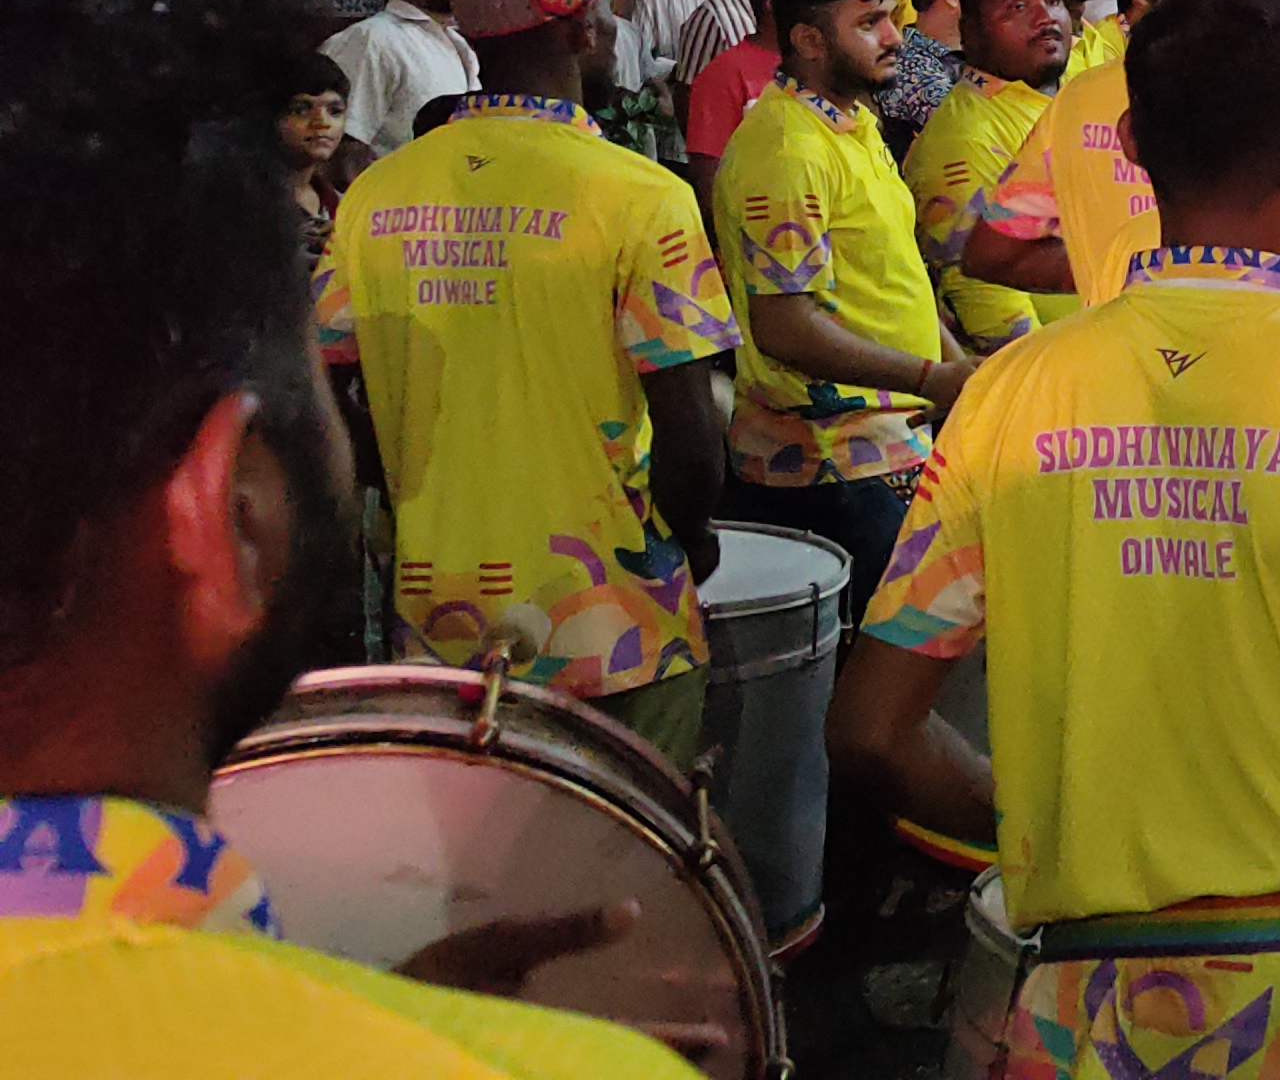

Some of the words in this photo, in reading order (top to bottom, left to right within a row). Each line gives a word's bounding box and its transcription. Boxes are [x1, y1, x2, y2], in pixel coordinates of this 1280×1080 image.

[369, 204, 571, 241] SIDDHIVINAYAK
[402, 238, 510, 269] MUSICAL
[416, 278, 499, 306] DIWALE
[1091, 476, 1249, 526] MUSICAL
[1120, 536, 1237, 579] DIWALE
